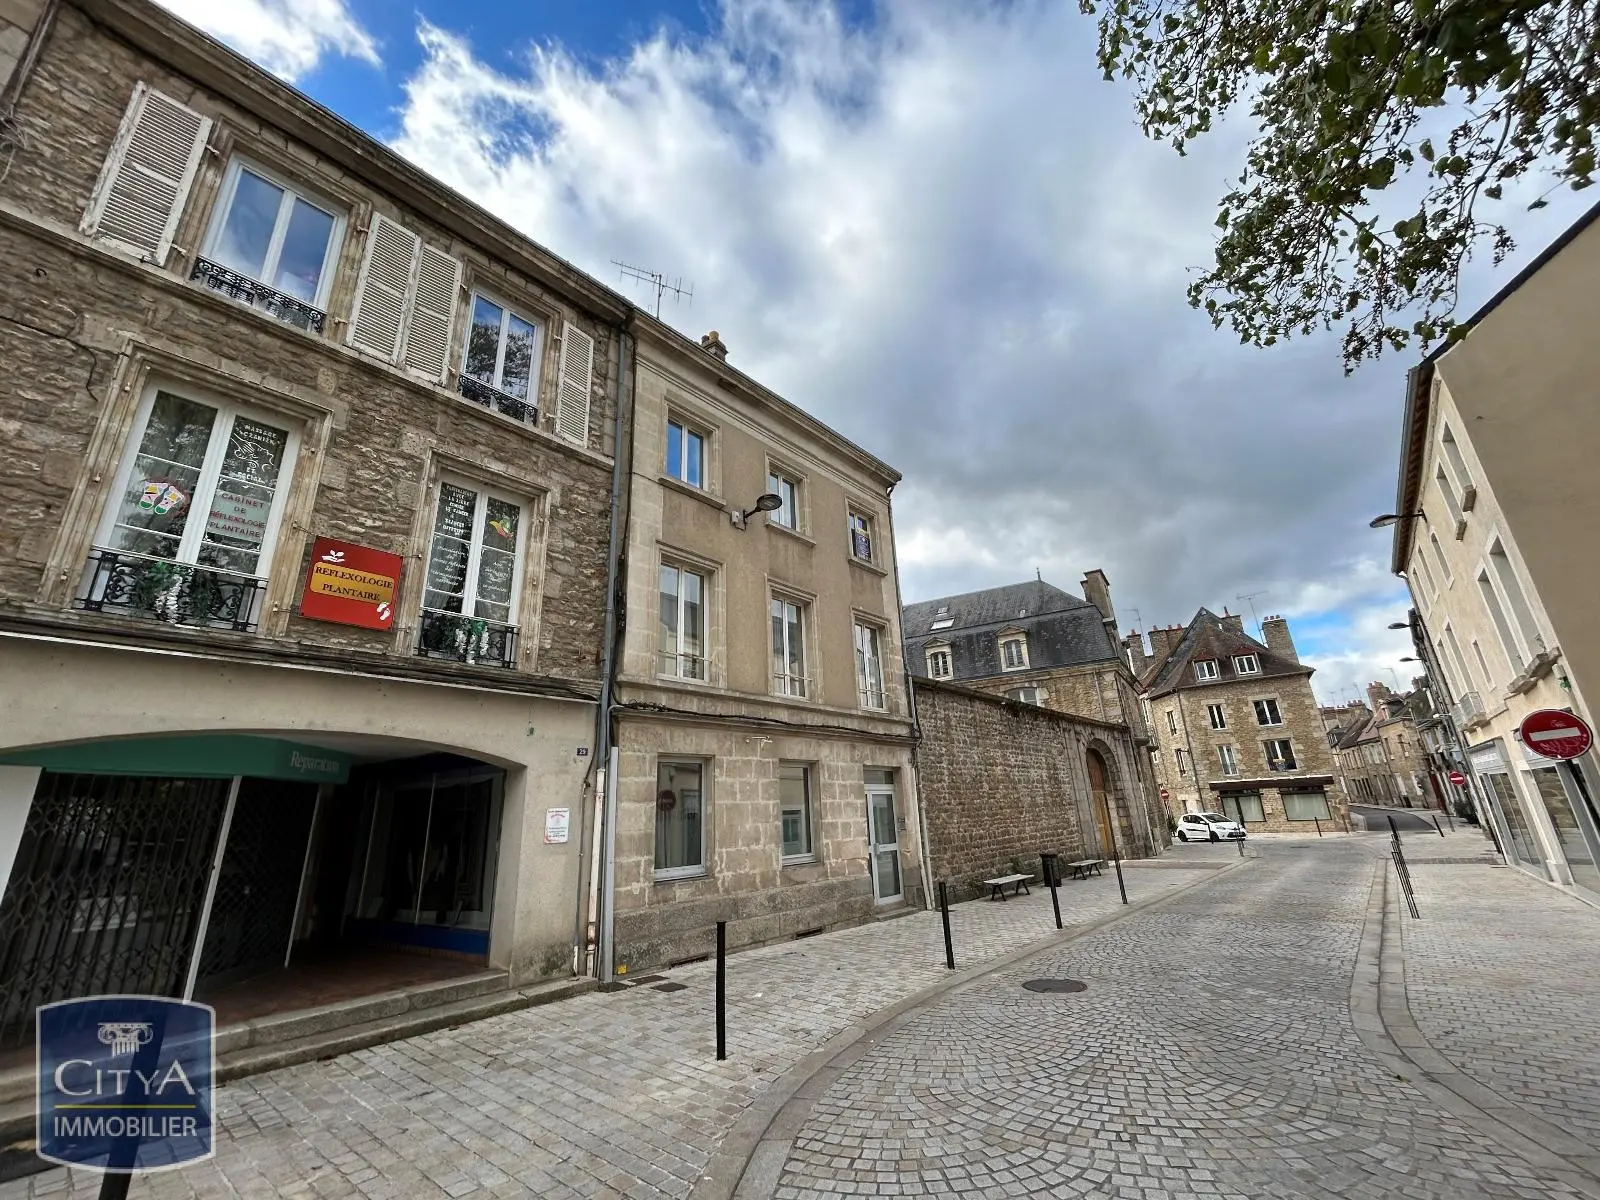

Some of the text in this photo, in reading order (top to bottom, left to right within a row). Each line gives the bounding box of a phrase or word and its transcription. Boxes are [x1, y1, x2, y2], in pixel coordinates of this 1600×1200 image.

[222, 493, 264, 509] CABINET
[234, 506, 246, 514] DE
[210, 521, 260, 538] PLANTAIRE
[314, 566, 394, 589] REFLEXOLOGIE
[322, 583, 380, 601] PLANTAIRE
